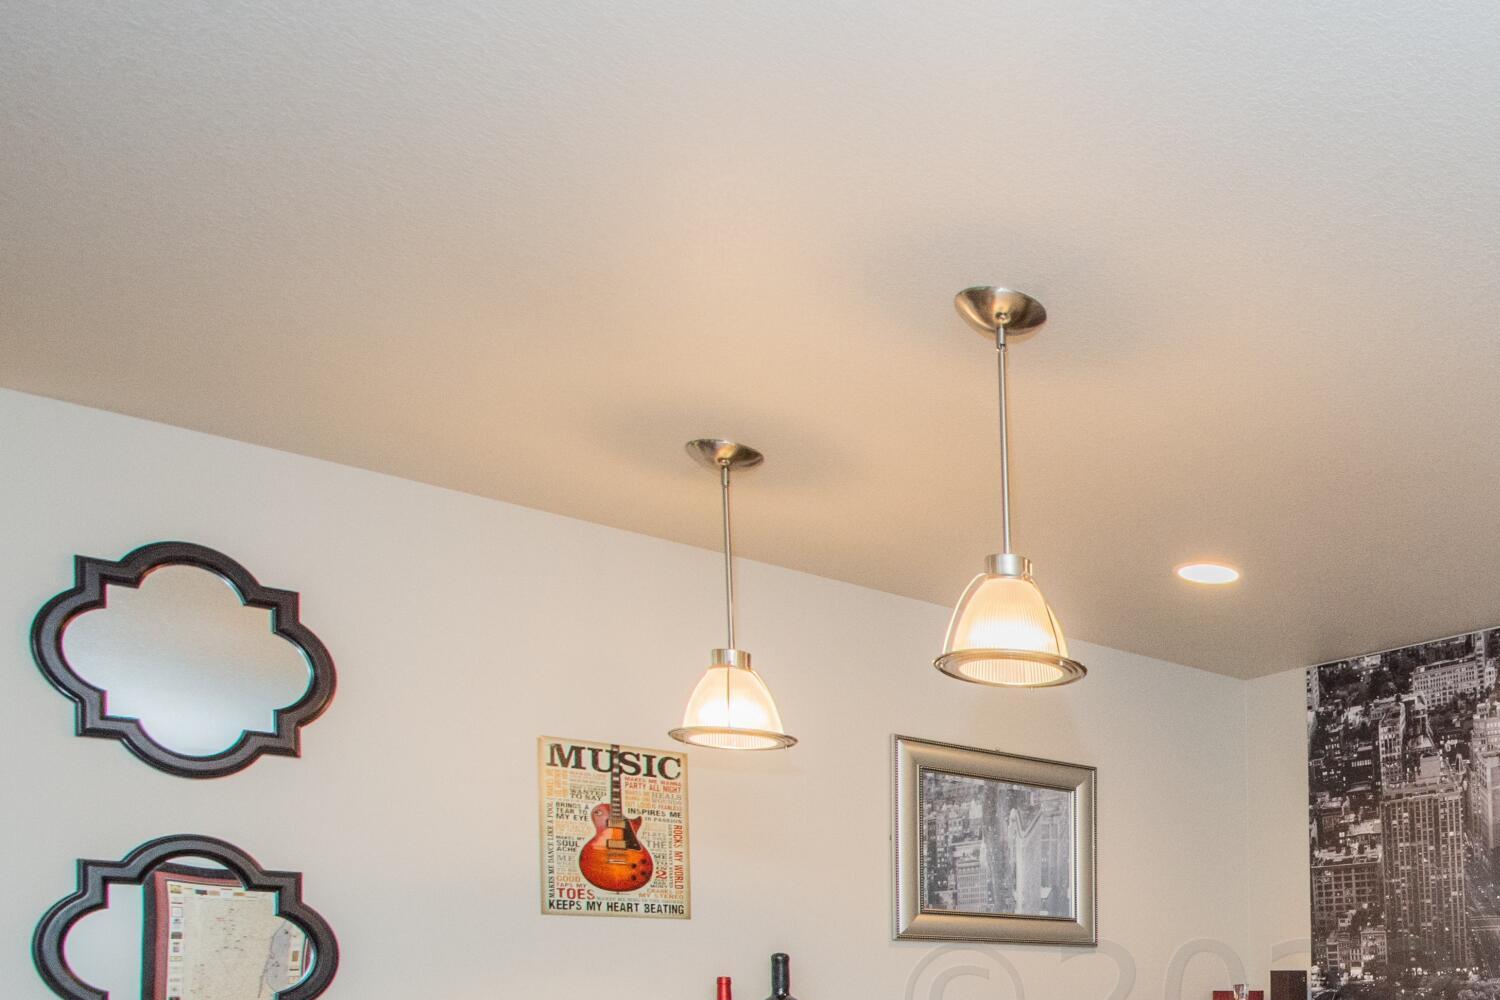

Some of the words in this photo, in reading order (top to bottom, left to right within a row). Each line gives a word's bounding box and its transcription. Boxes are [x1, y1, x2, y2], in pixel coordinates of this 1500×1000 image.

[546, 743, 681, 780] MUSIC
[556, 801, 581, 809] BRINGS
[627, 807, 666, 817] INSPIRES
[669, 811, 682, 819] ME
[673, 824, 683, 848] ROCKS
[556, 839, 580, 848] SOUL
[674, 851, 683, 861] MY
[656, 869, 667, 880] 2
[674, 864, 684, 890] WORLD
[556, 887, 595, 900] TOES
[549, 899, 582, 910] KEEPS
[586, 901, 602, 911] MY
[607, 902, 639, 913] HEART
[644, 903, 685, 915] BEATING
